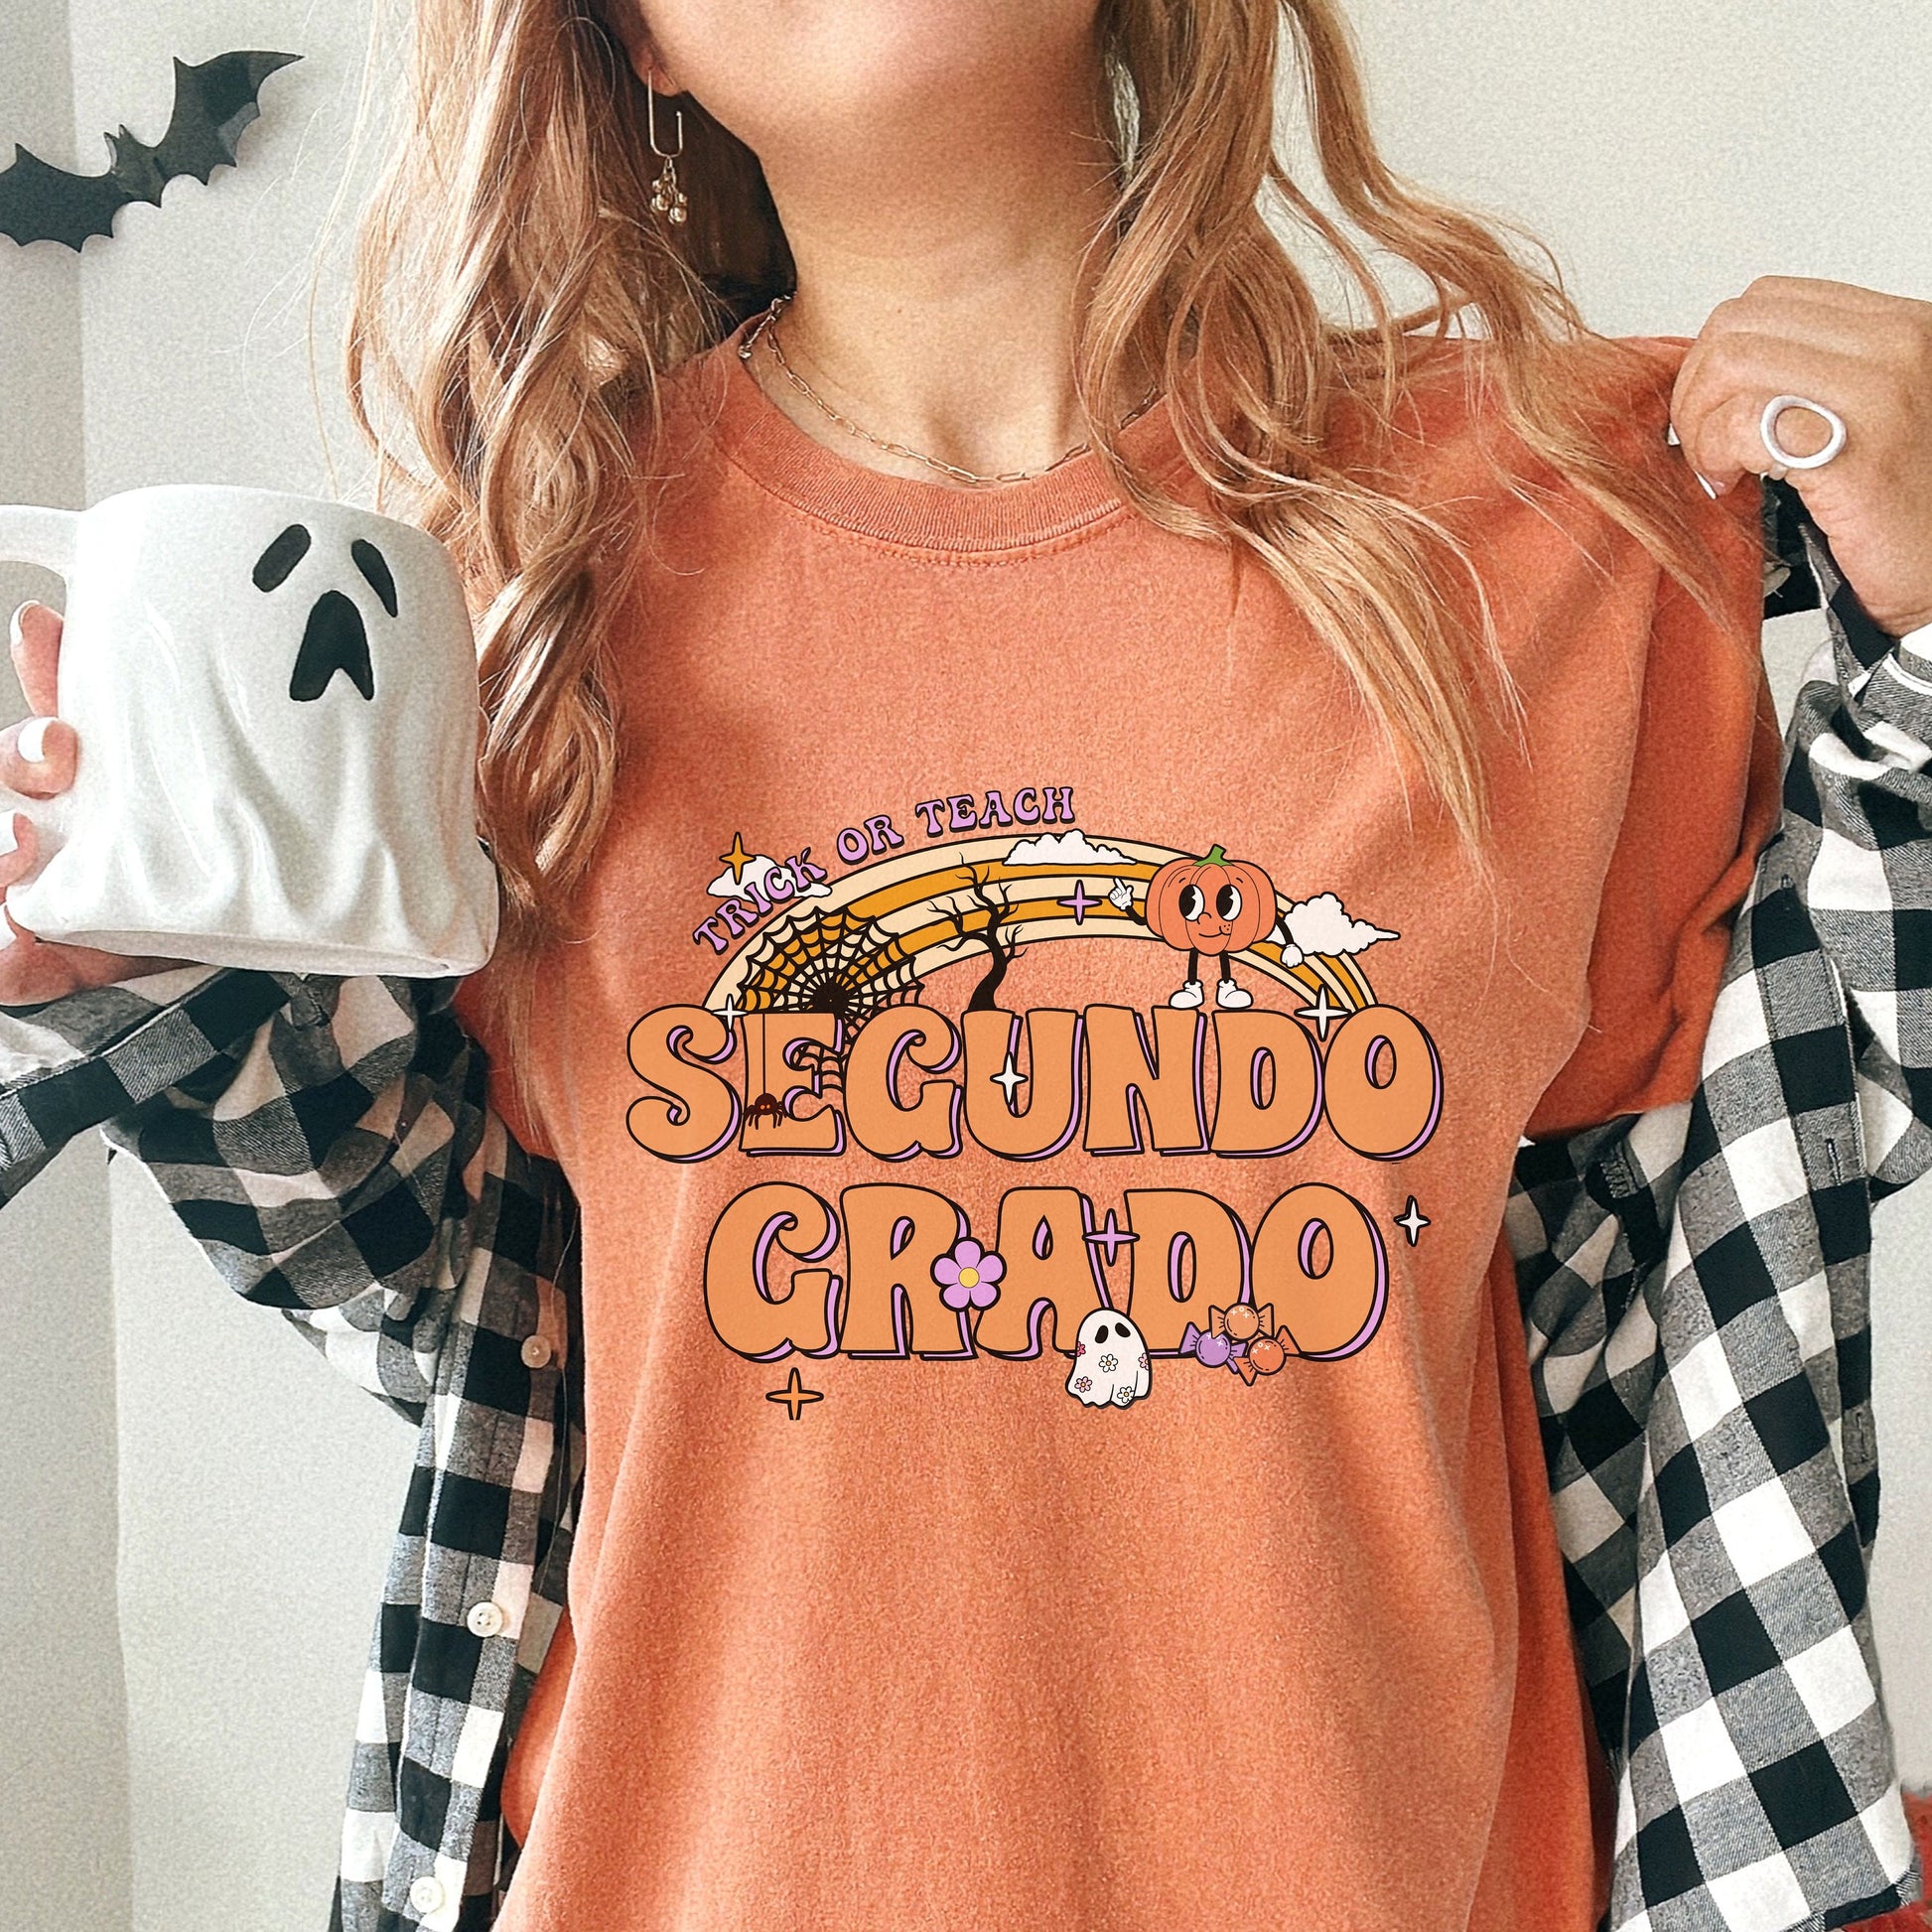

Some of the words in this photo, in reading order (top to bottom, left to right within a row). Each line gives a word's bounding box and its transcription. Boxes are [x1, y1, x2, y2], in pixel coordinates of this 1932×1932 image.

[693, 847, 828, 955] TRICK
[836, 814, 904, 866] OR
[914, 786, 1076, 838] TEACH
[626, 1005, 1444, 1161] SEGUNDO
[703, 1181, 1390, 1362] GRADO
